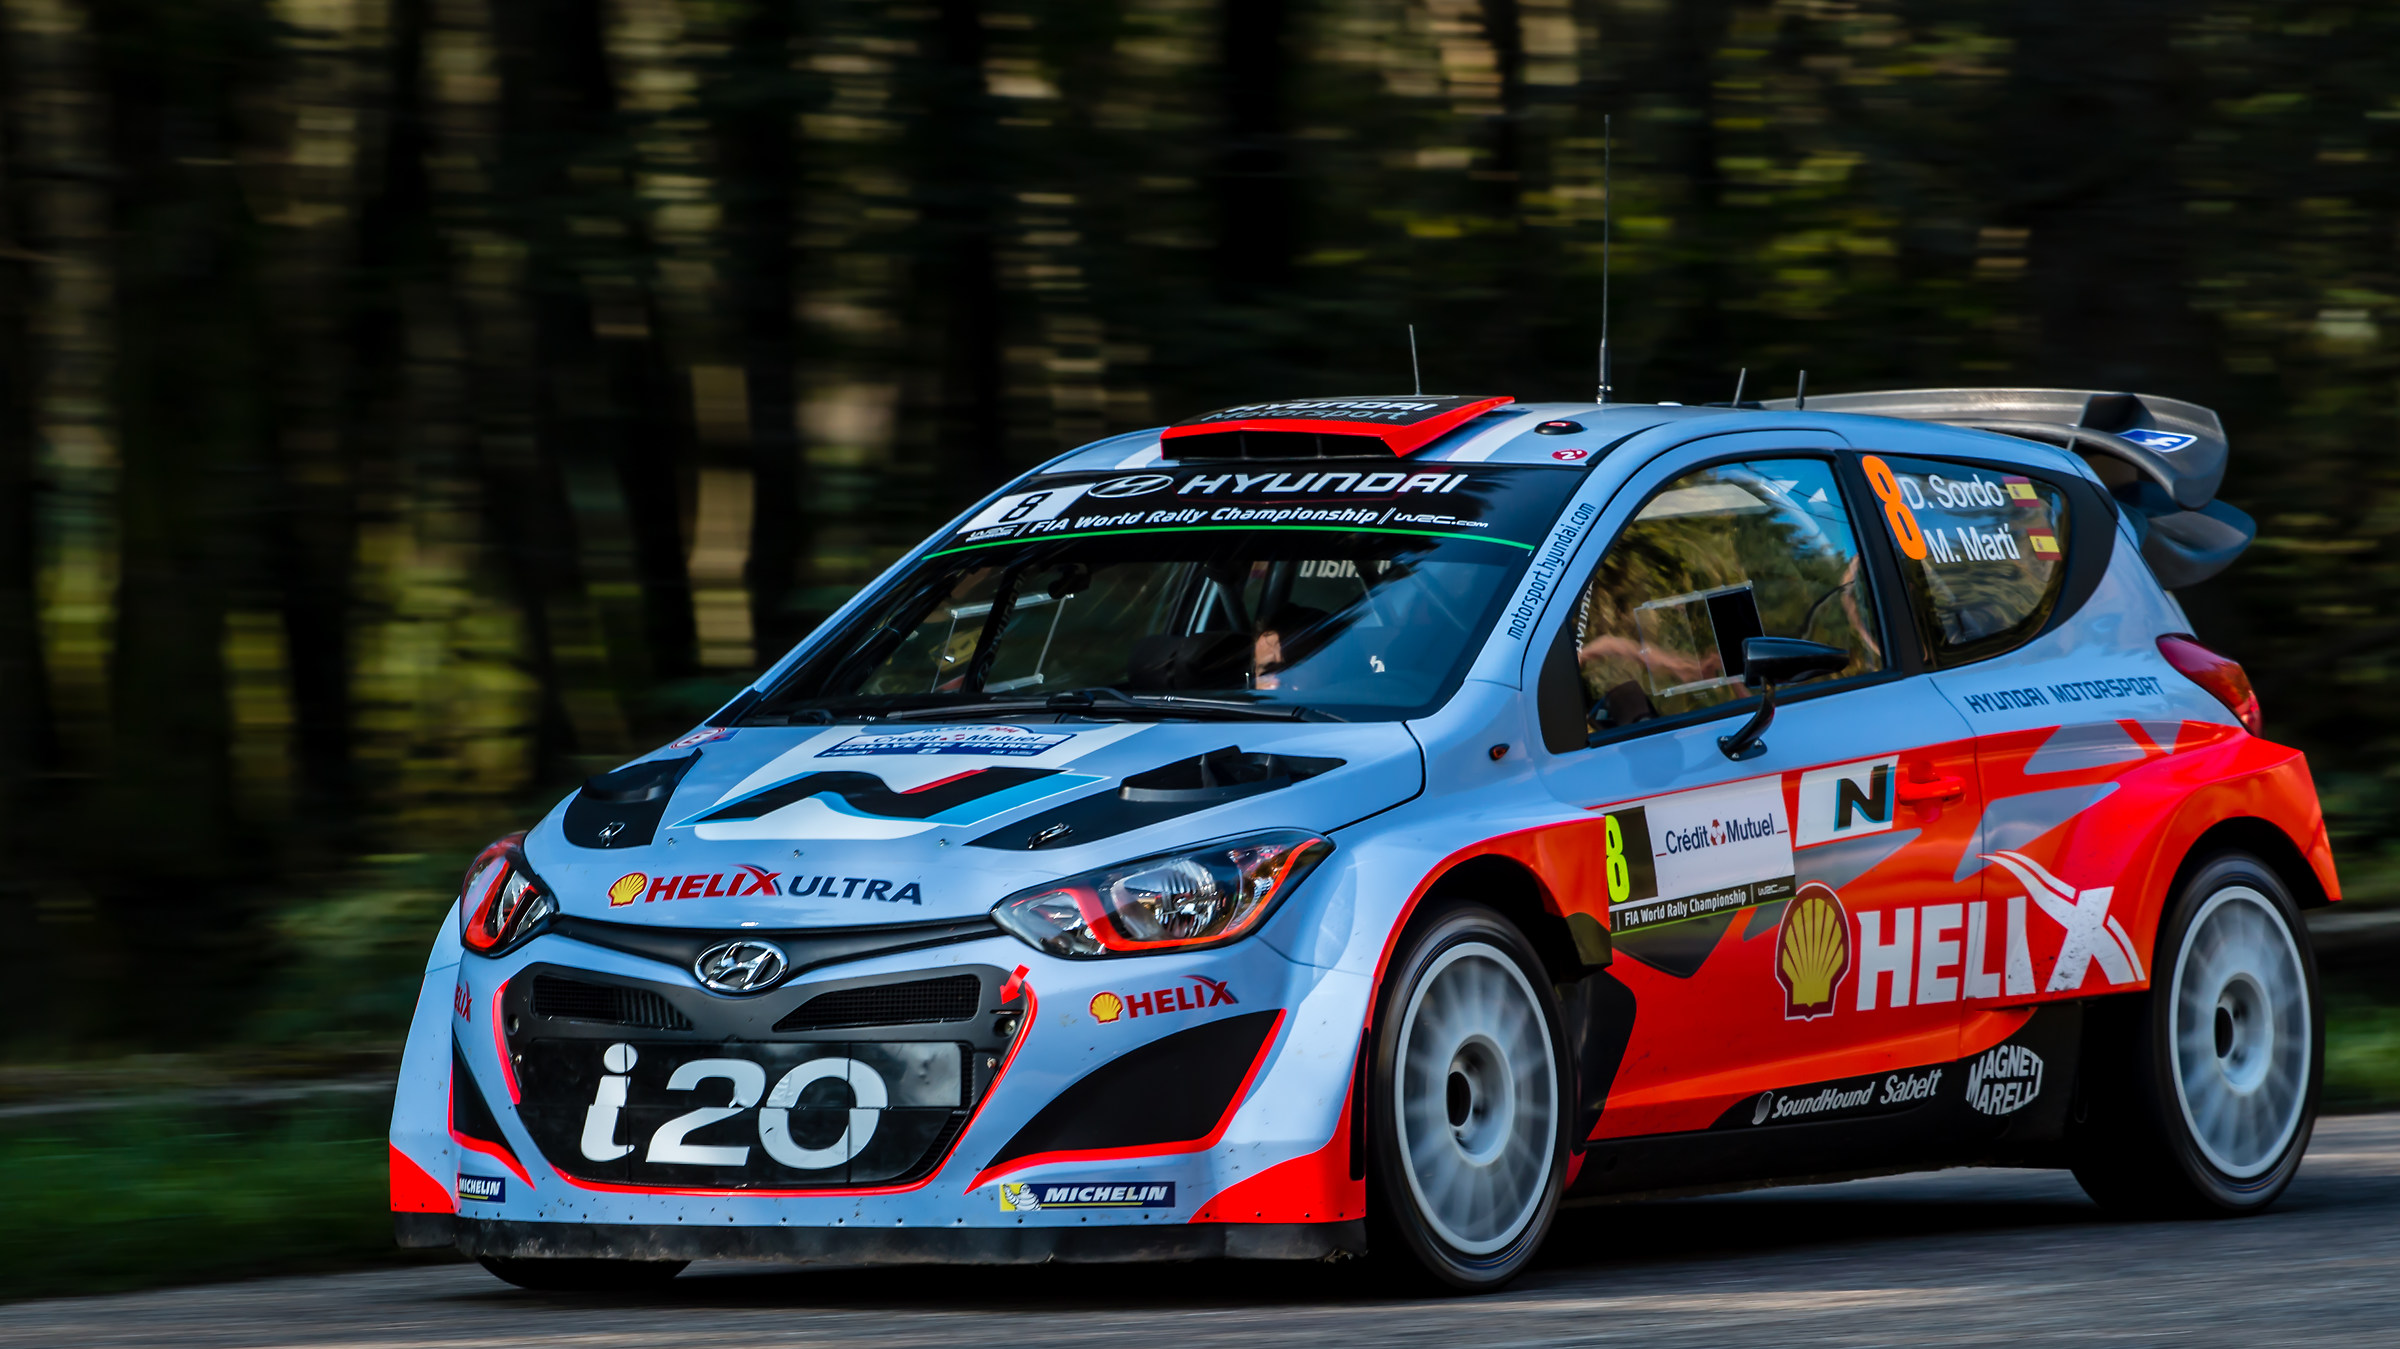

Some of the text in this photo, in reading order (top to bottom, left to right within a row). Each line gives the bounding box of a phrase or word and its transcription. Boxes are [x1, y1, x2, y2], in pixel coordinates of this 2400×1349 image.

[1200, 409, 1408, 422] Motorsport
[1225, 401, 1438, 413] HYUNDAI
[1177, 473, 1469, 495] HYUNDAI
[1898, 473, 2005, 510] D. Sordo
[998, 491, 1053, 524] 8
[1029, 518, 1067, 534] FIA
[1074, 511, 1145, 529] World
[1145, 507, 1208, 525] Rally
[1211, 507, 1379, 525] Championship
[1862, 455, 1927, 560] 8
[1923, 522, 2021, 564] M. Martí
[1506, 502, 1596, 641] motorsport.hyundai.com
[1963, 676, 2165, 714] HYUNDAI MOTORSPORT
[1665, 813, 1775, 854] Crédit Mutuel
[1605, 815, 1630, 903] 8
[645, 865, 922, 905] HELIX ULTRA
[1625, 910, 1640, 927] FIA
[1640, 907, 1665, 923] World
[1667, 901, 1688, 918] Rally
[1689, 889, 1747, 913] Championship
[1857, 850, 2147, 1011] HELIX
[1124, 975, 1240, 1019] HELIX
[581, 1042, 889, 1170] i20
[1771, 1069, 1943, 1119] SoundHound Sabelt
[459, 1178, 501, 1196] MICHELIN
[1044, 1186, 1169, 1202] MICHELIN
